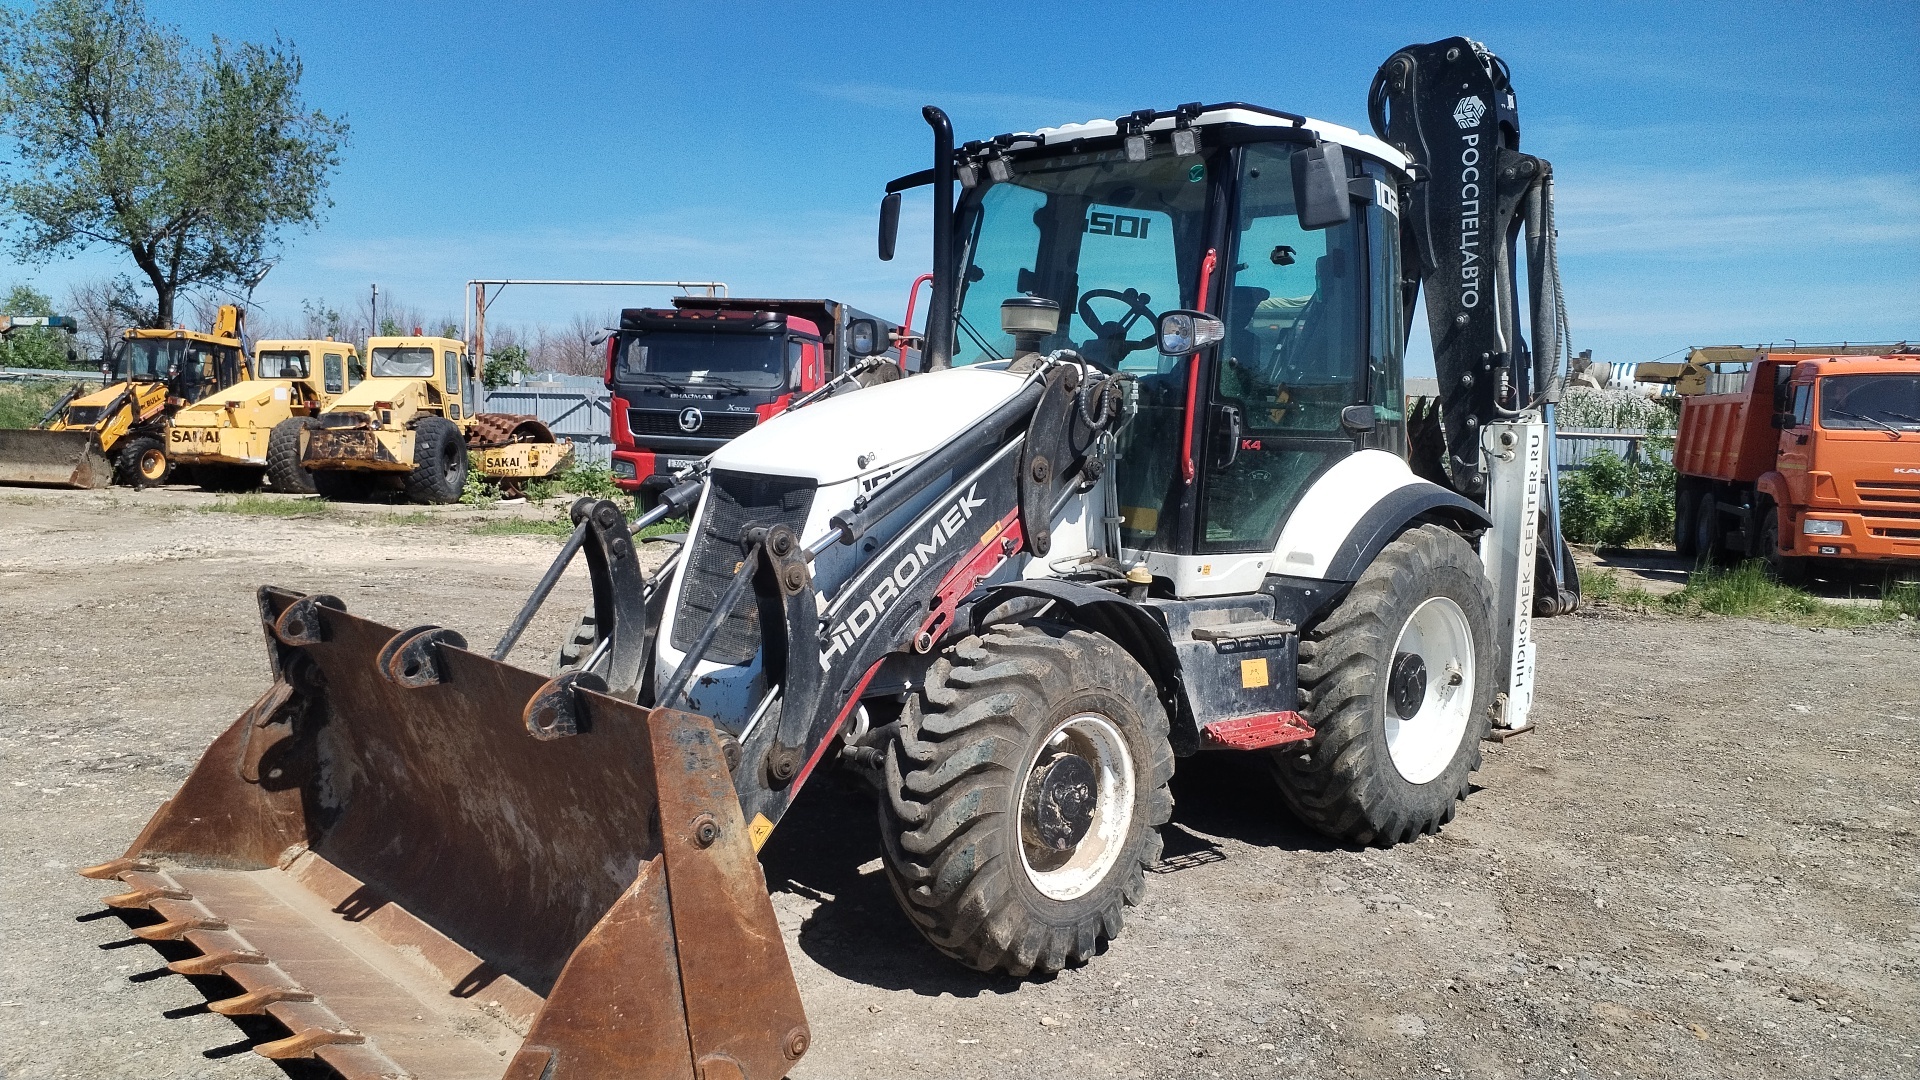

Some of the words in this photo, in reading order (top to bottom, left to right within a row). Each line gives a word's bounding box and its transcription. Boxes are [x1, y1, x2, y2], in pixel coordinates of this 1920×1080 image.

[1044, 150, 1126, 169] ALPHA
[1459, 133, 1480, 308] РОССПЕЦАВТО
[486, 456, 520, 468] SAKAI
[1241, 439, 1261, 451] K4
[818, 481, 987, 674] HIDROMEK
[1515, 434, 1540, 688] HIDROMEK-CENTER.RU
